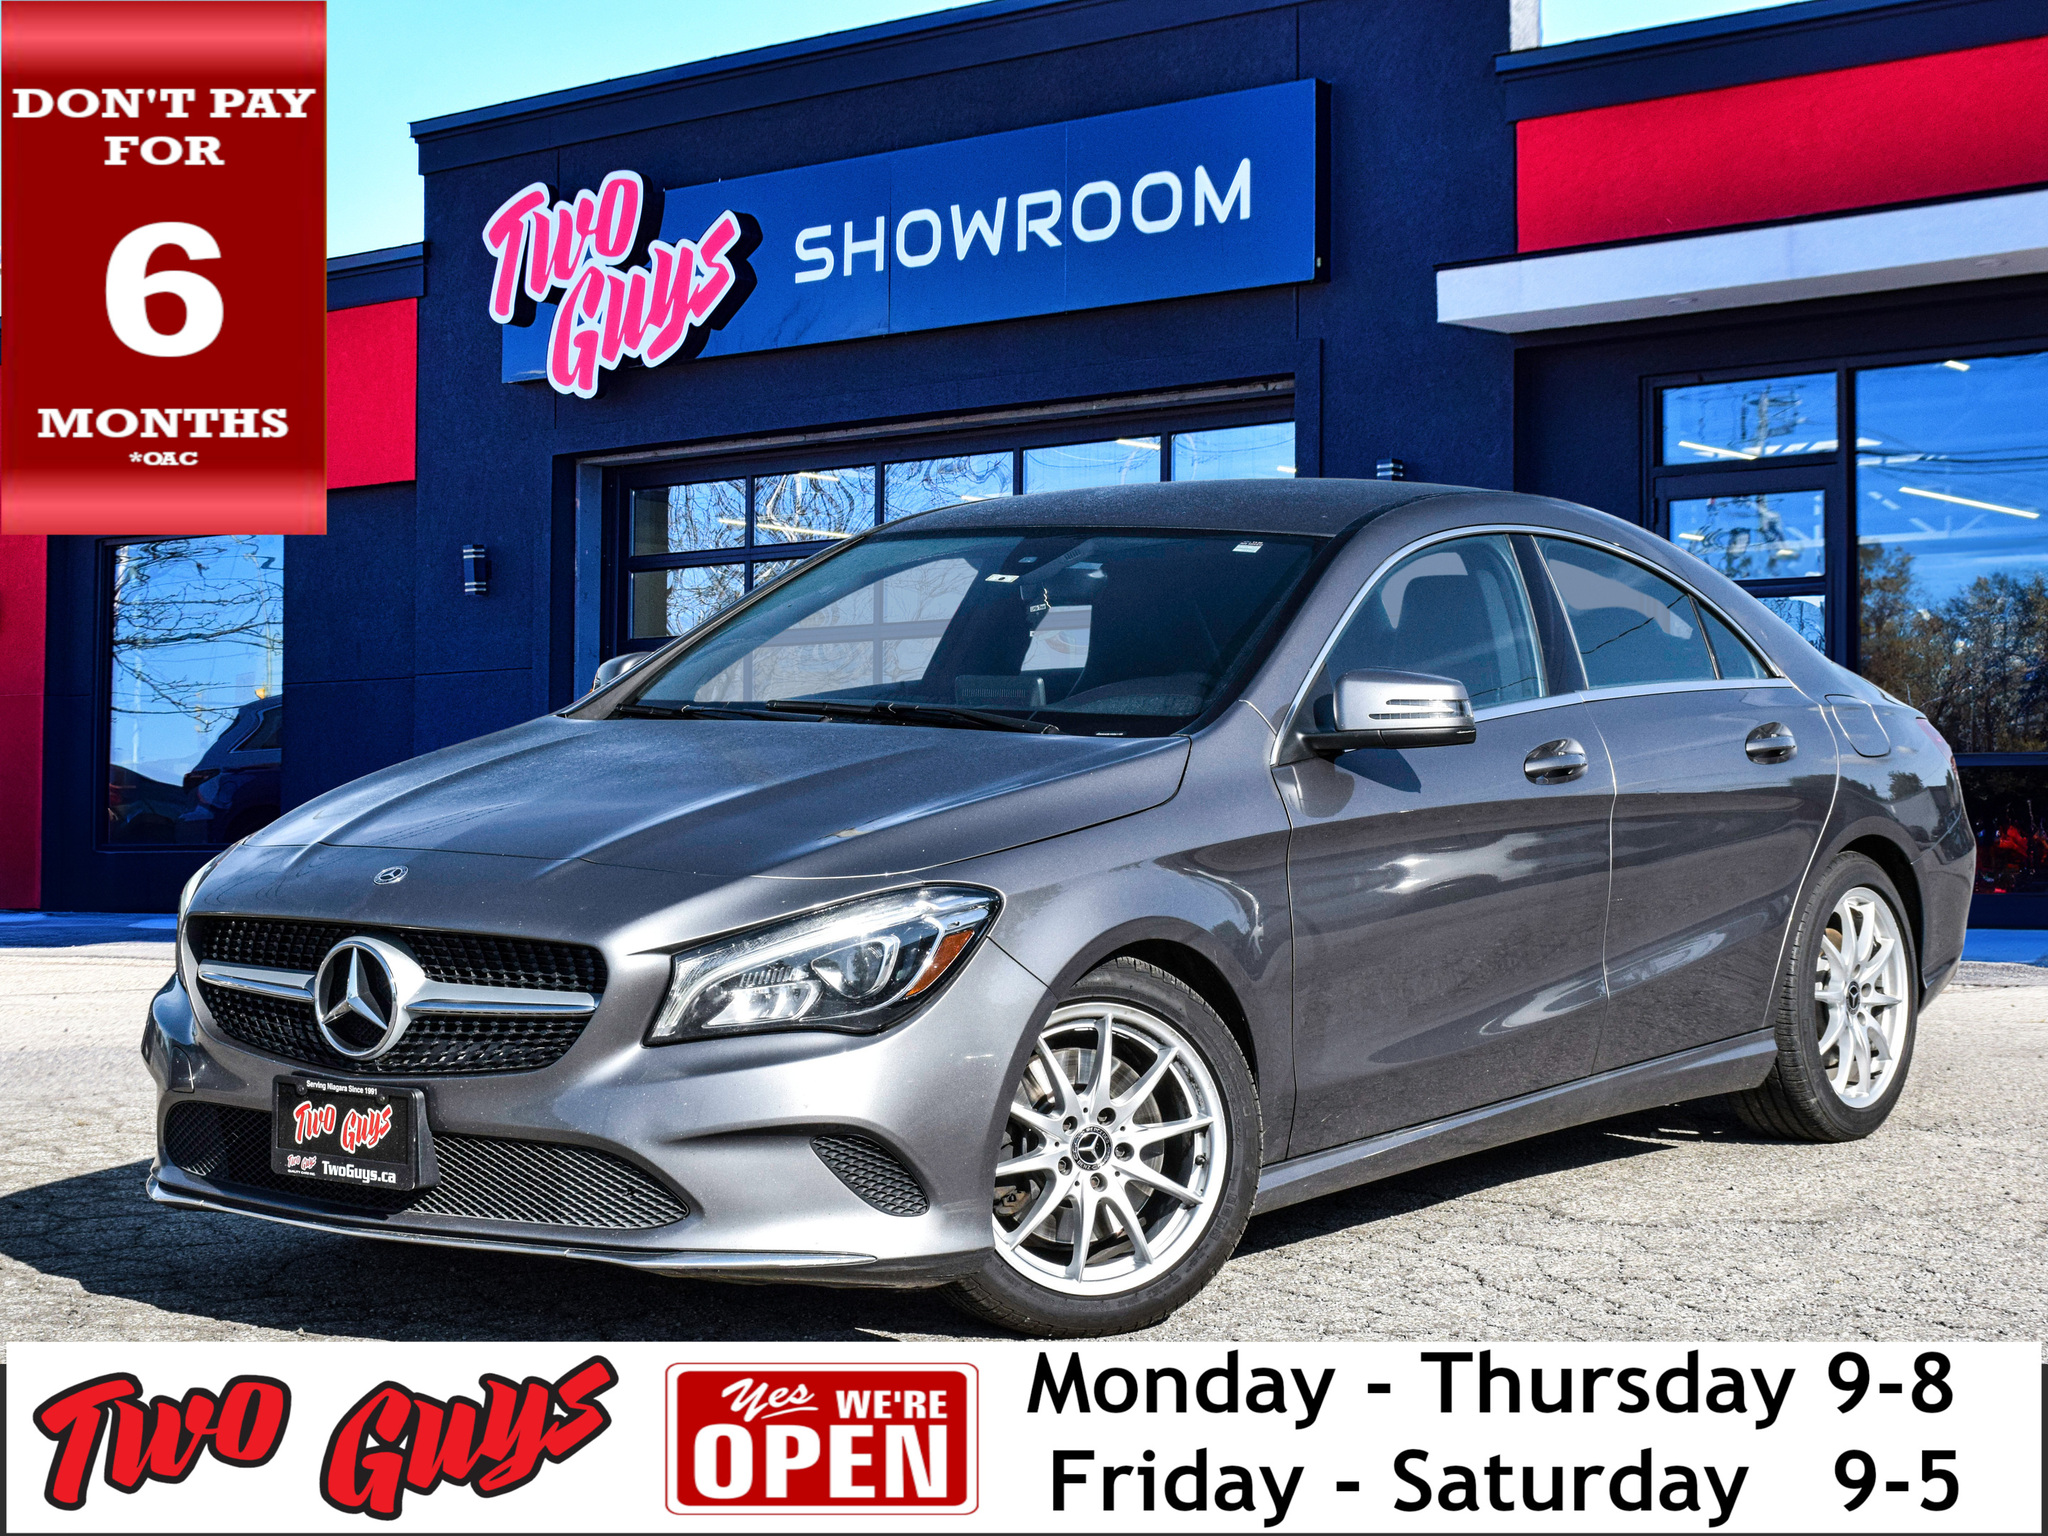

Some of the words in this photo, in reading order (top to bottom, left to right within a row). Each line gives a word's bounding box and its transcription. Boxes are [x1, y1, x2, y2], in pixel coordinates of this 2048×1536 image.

[482, 170, 643, 324] Two
[795, 158, 1251, 283] SHOWROOM
[546, 209, 741, 399] Guys
[293, 1100, 337, 1145] Two
[340, 1104, 393, 1154] Guys
[306, 1080, 326, 1091] Serving
[327, 1082, 348, 1092] Niagara
[348, 1085, 364, 1094] Since
[365, 1087, 378, 1095] 1991
[321, 1160, 397, 1184] TwoGuys.ca
